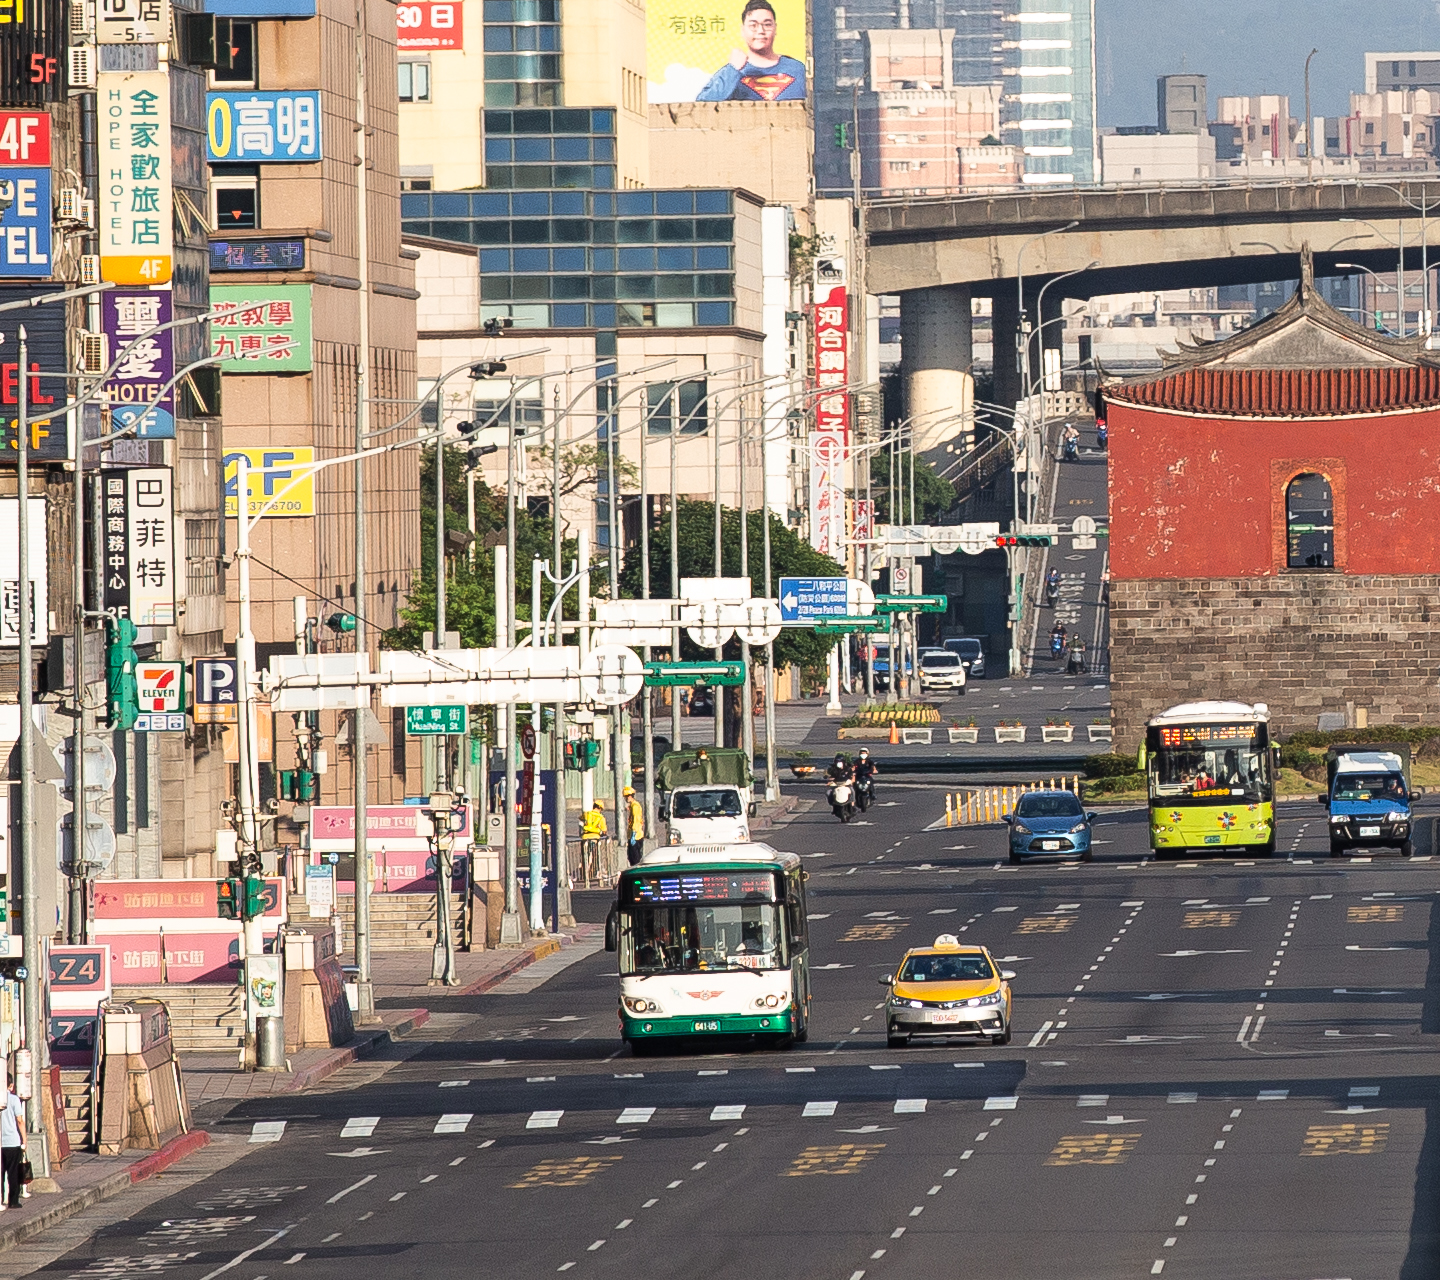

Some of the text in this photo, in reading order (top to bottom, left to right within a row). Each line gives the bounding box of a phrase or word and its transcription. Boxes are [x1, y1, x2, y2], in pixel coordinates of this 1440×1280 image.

[30, 53, 57, 83] 5F
[109, 89, 123, 246] HOPE HOTEL
[130, 89, 160, 245] 全家歡旅店
[139, 259, 163, 278] 4F
[107, 383, 172, 402] HOTEL
[107, 478, 126, 590] 國際商務中心
[136, 479, 166, 588] 巴菲特
[202, 662, 234, 702] P
[412, 708, 461, 721] 懷寧街
[123, 892, 205, 908] 站前地下街
[58, 958, 97, 981] Z4
[123, 950, 205, 968] 站前地下街
[58, 1021, 94, 1046] Z4
